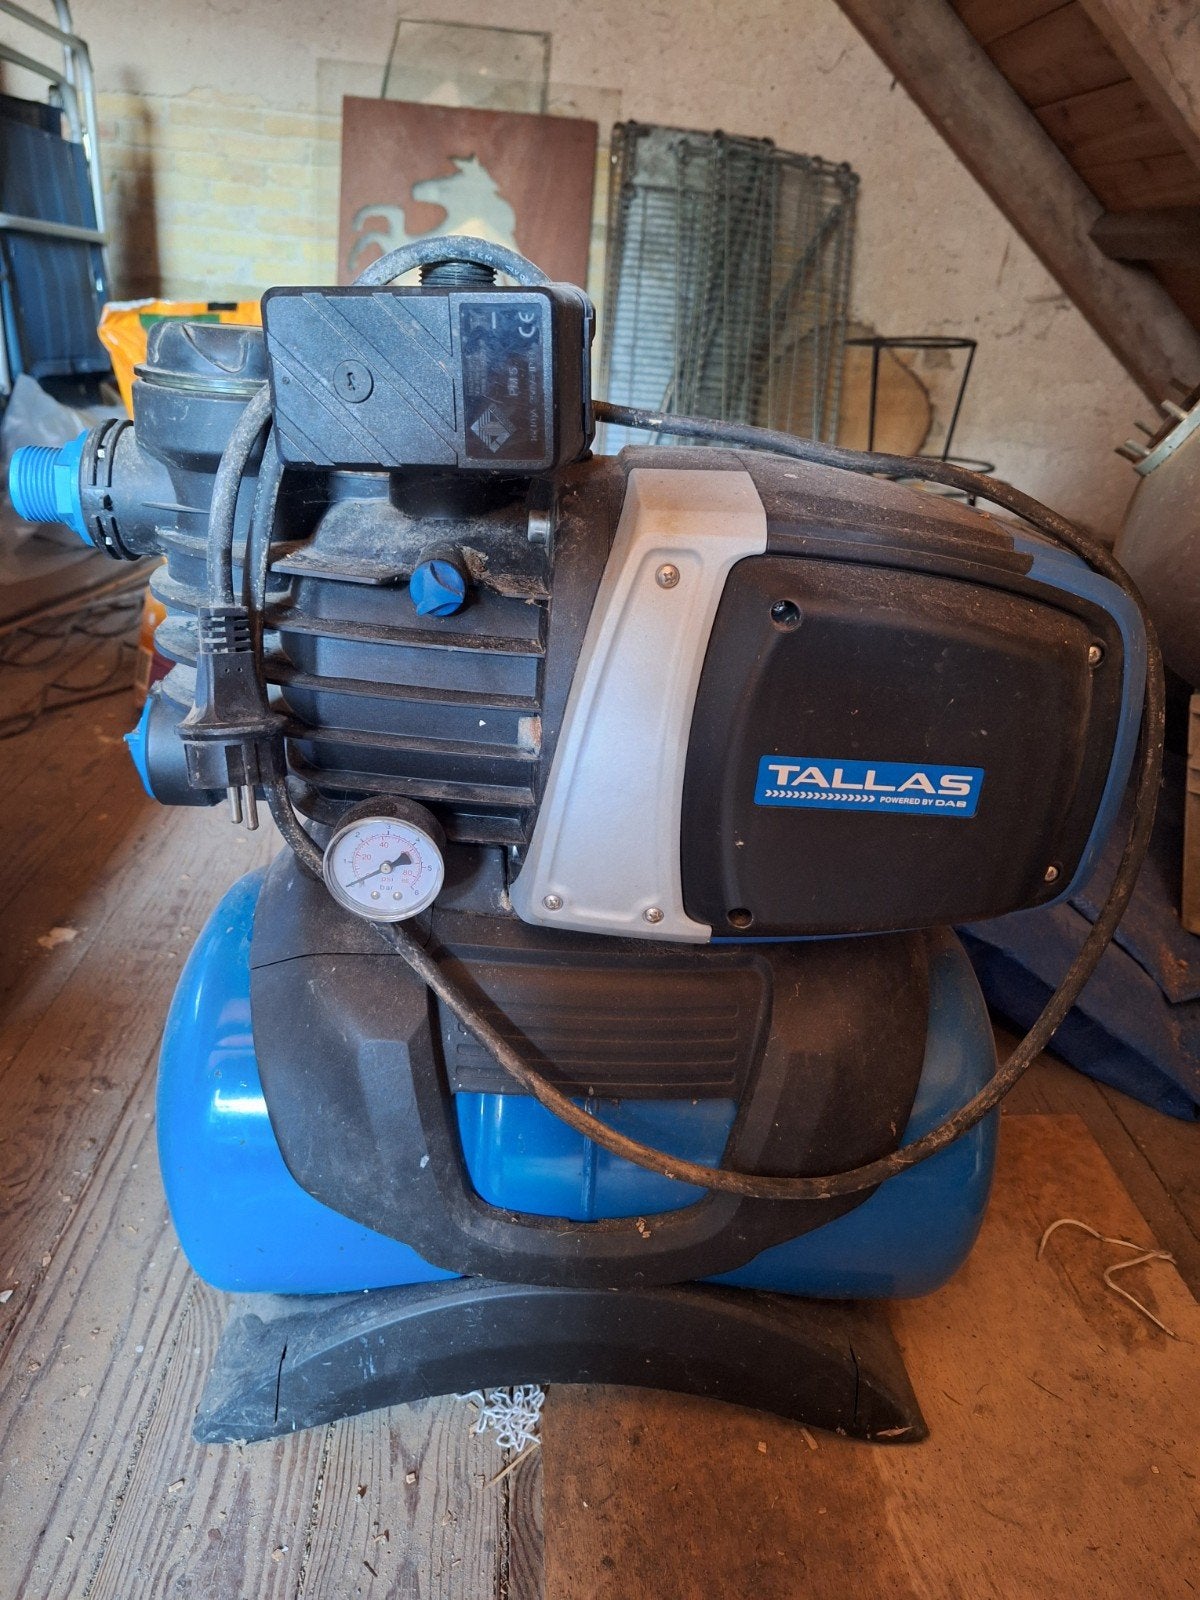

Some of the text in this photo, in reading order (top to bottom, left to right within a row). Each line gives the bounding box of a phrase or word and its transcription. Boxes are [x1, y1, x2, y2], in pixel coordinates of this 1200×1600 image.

[768, 764, 973, 796] TALLAS
[879, 796, 921, 806] POWERED
[921, 797, 933, 806] BY
